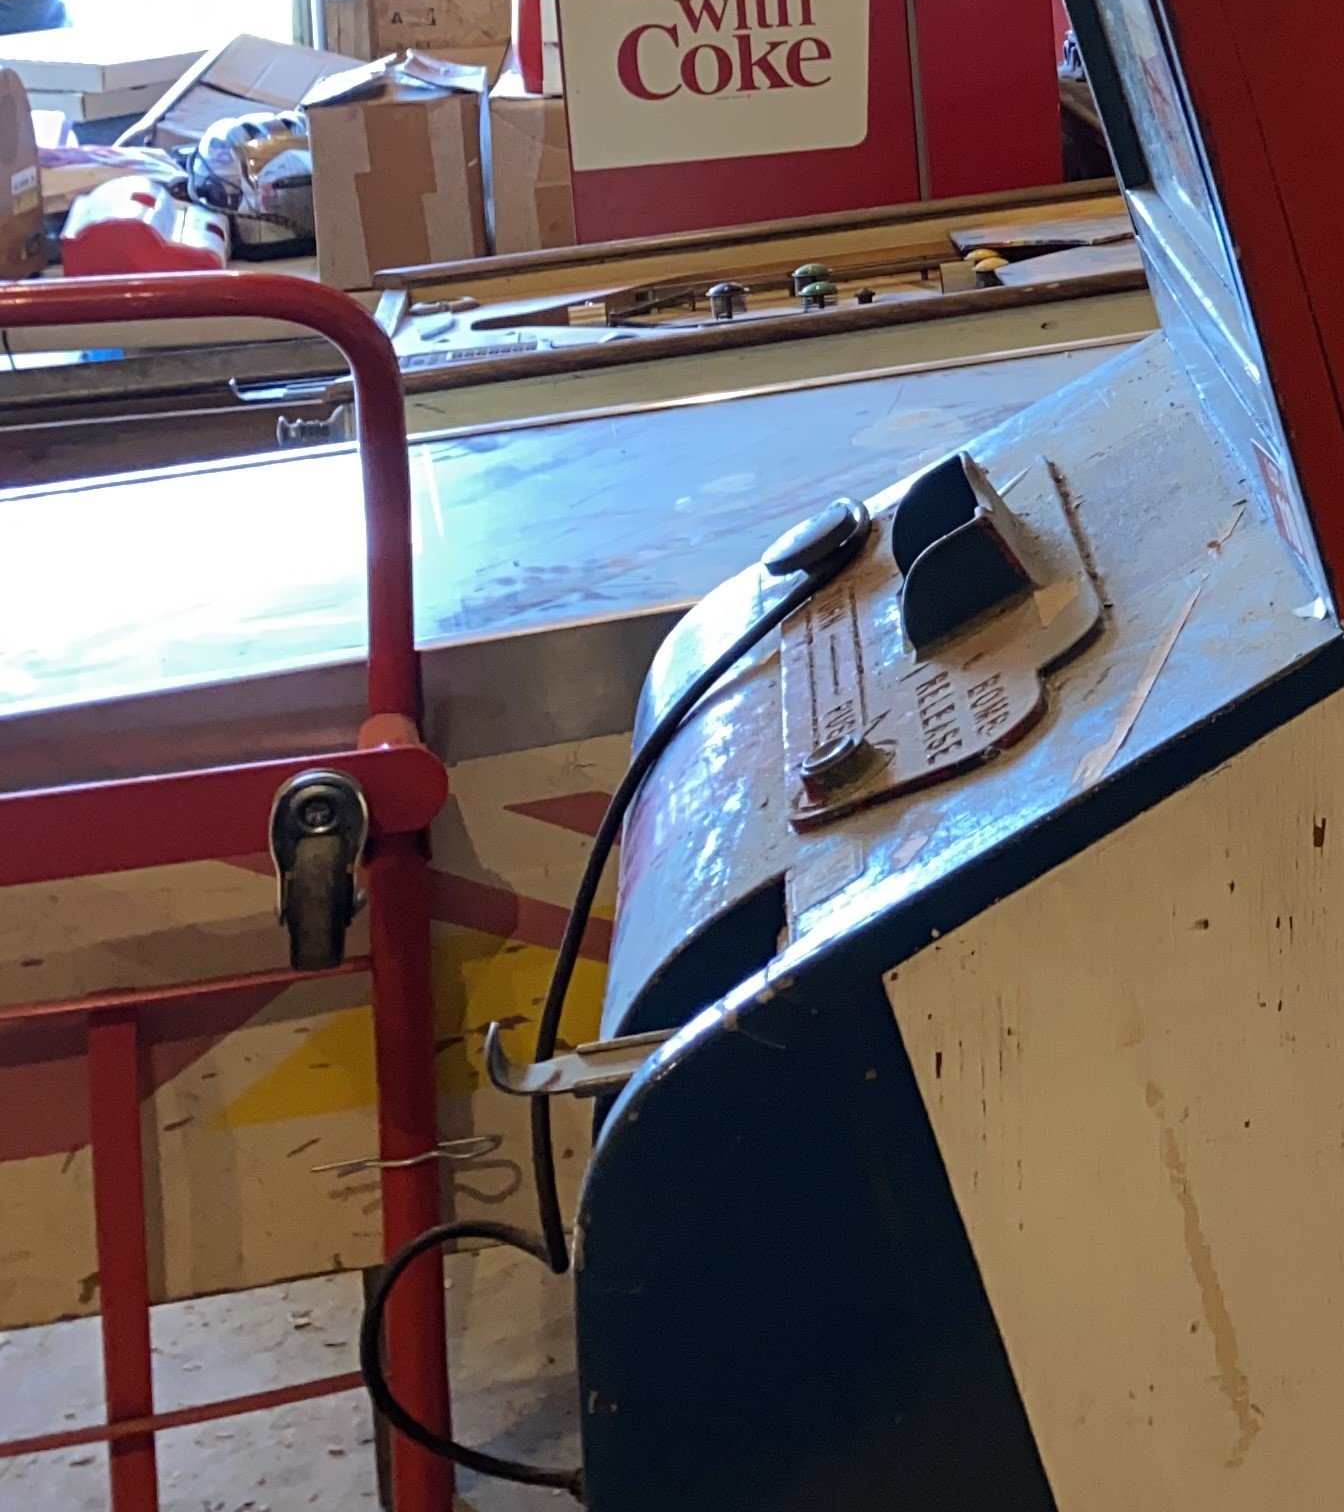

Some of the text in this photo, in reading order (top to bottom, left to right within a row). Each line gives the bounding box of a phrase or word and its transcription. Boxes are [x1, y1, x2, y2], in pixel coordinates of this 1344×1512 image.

[616, 22, 832, 101] Coke
[823, 700, 858, 740] PUS
[915, 670, 962, 765] RELEASE
